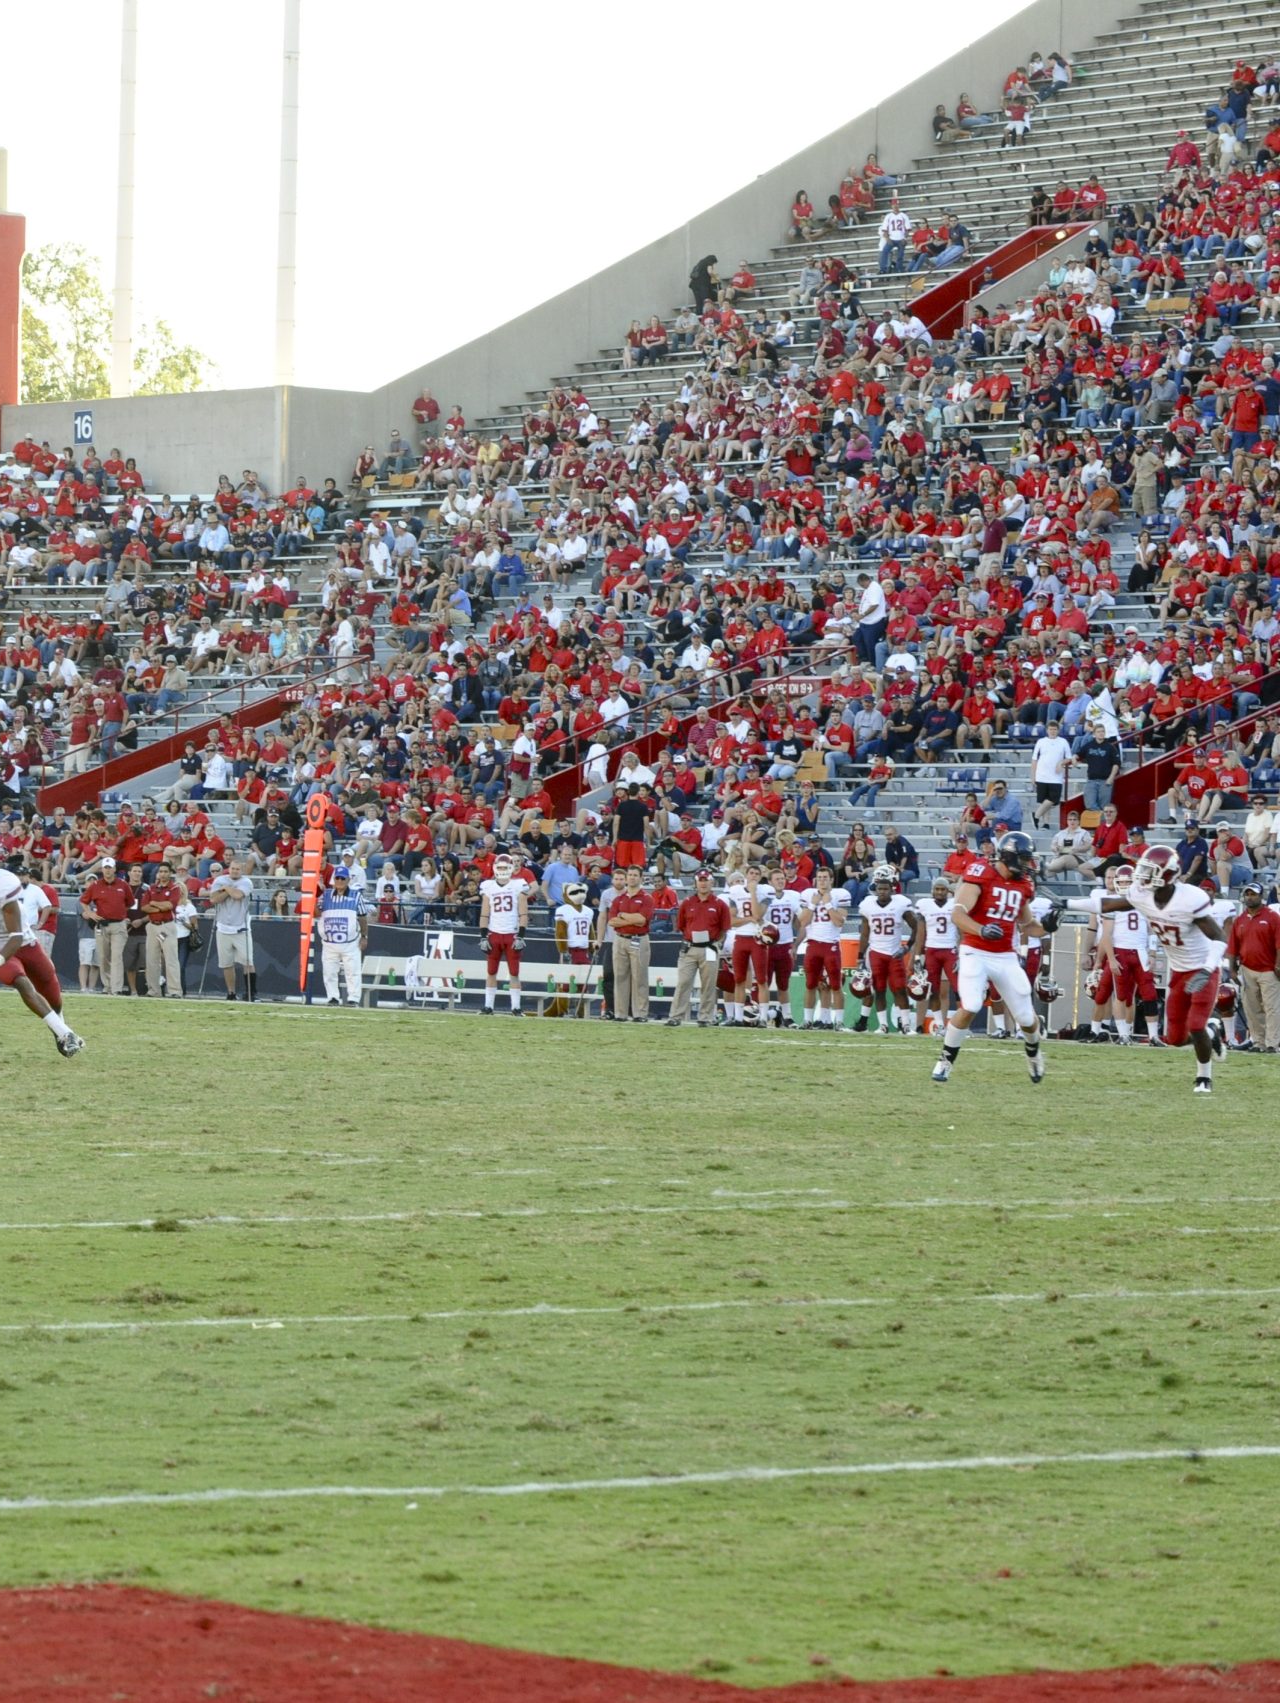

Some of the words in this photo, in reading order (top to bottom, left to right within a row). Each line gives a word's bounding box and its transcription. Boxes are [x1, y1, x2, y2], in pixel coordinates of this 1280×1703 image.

[74, 414, 92, 439] 16
[493, 895, 514, 912] 23
[986, 886, 1023, 922] 39
[770, 907, 792, 925] 63
[936, 916, 948, 934] 3
[1127, 912, 1139, 931] 8
[324, 924, 348, 932] PAC
[575, 920, 588, 936] 12
[872, 917, 895, 935] 32
[325, 931, 348, 943] 10
